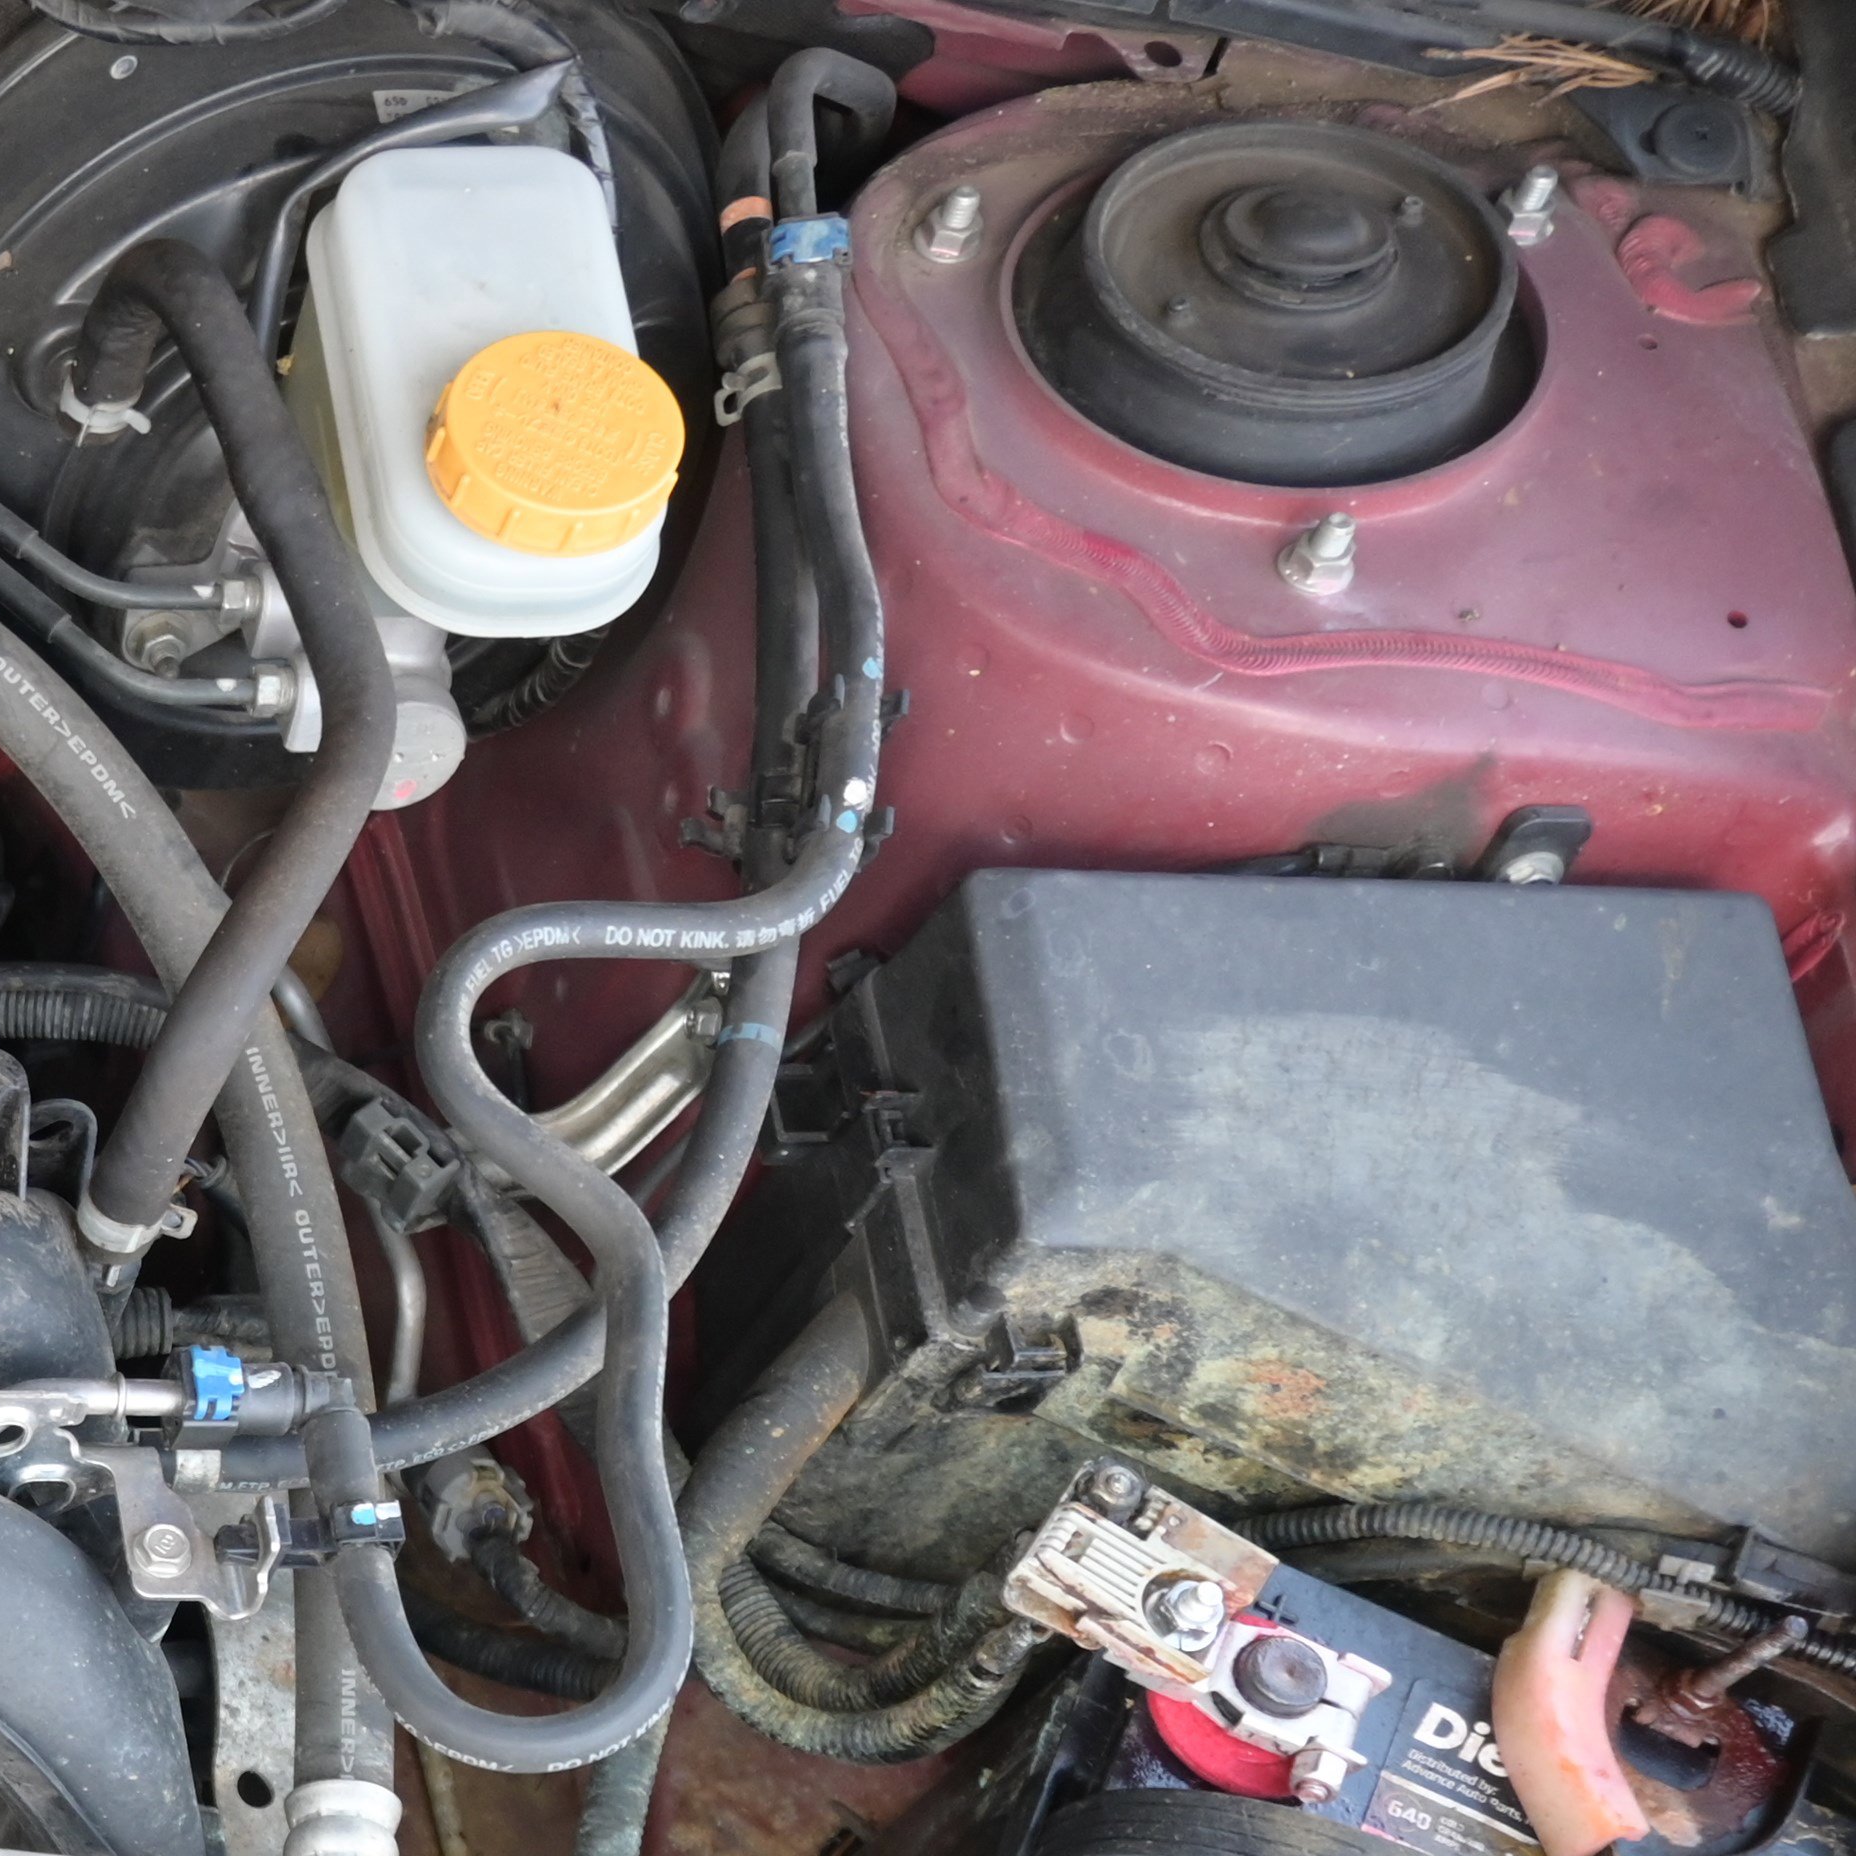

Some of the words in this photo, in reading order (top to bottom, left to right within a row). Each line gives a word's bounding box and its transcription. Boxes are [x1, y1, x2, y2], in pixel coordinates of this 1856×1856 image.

[605, 925, 633, 946] DO
[636, 927, 675, 948] NOT
[680, 930, 730, 949] KINK.
[295, 1209, 338, 1378] OUTER>EPD
[341, 1669, 356, 1780] INNER>
[1401, 1760, 1456, 1790] Advance
[1456, 1784, 1487, 1804] Auto
[1408, 1748, 1482, 1787] Distributed
[1478, 1777, 1499, 1797] by:
[1388, 1800, 1432, 1831] 640
